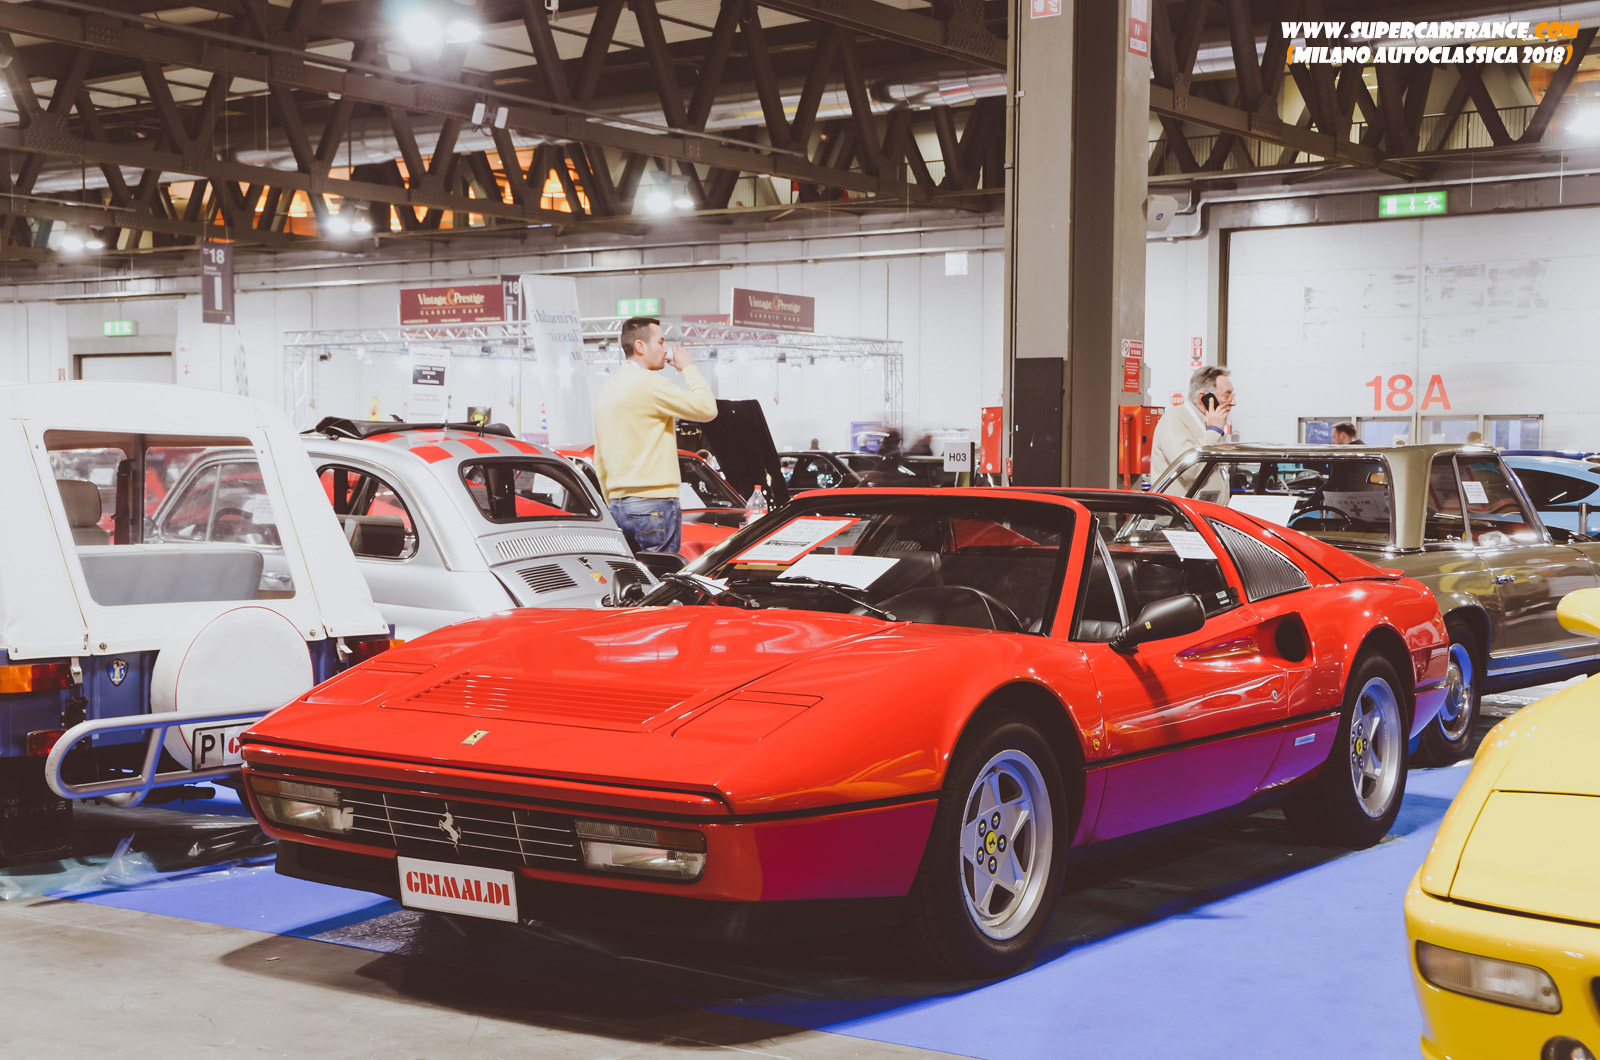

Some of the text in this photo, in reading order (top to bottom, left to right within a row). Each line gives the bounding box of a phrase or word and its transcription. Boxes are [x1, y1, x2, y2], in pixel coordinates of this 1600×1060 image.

[209, 248, 225, 265] 18
[508, 281, 519, 295] 18
[418, 293, 447, 306] Vintage
[454, 291, 485, 304] Prestige
[749, 296, 771, 310] Vintage
[778, 299, 801, 314] Prestige
[750, 312, 779, 320] CLASSIC
[1171, 396, 1184, 404] STOP
[949, 452, 967, 462] H03
[406, 871, 510, 906] GRIMALDI
